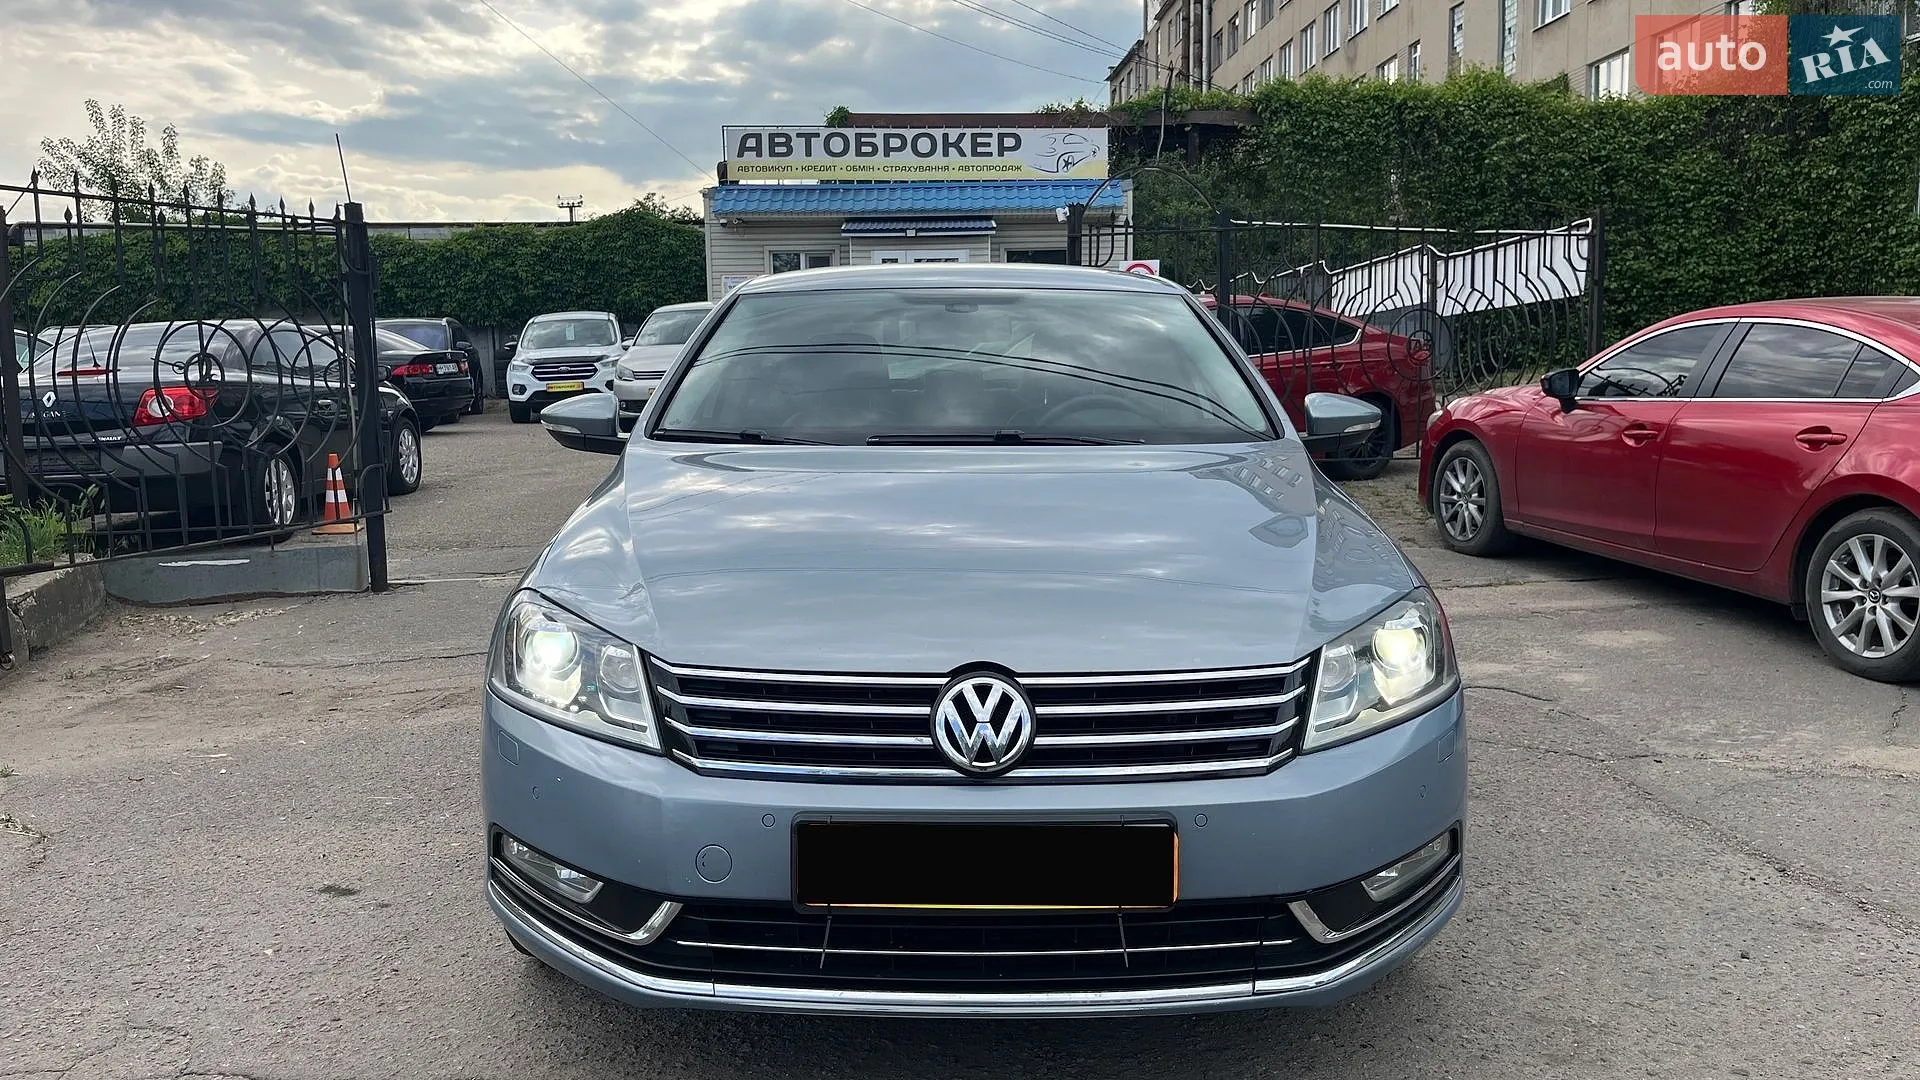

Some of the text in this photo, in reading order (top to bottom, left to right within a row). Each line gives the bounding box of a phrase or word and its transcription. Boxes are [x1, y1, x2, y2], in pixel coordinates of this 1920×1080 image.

[737, 132, 1022, 158] АВТОБРОКЕР
[737, 165, 793, 173] АВТОВИКУП
[882, 165, 950, 173] СТРАХУВАННЯ
